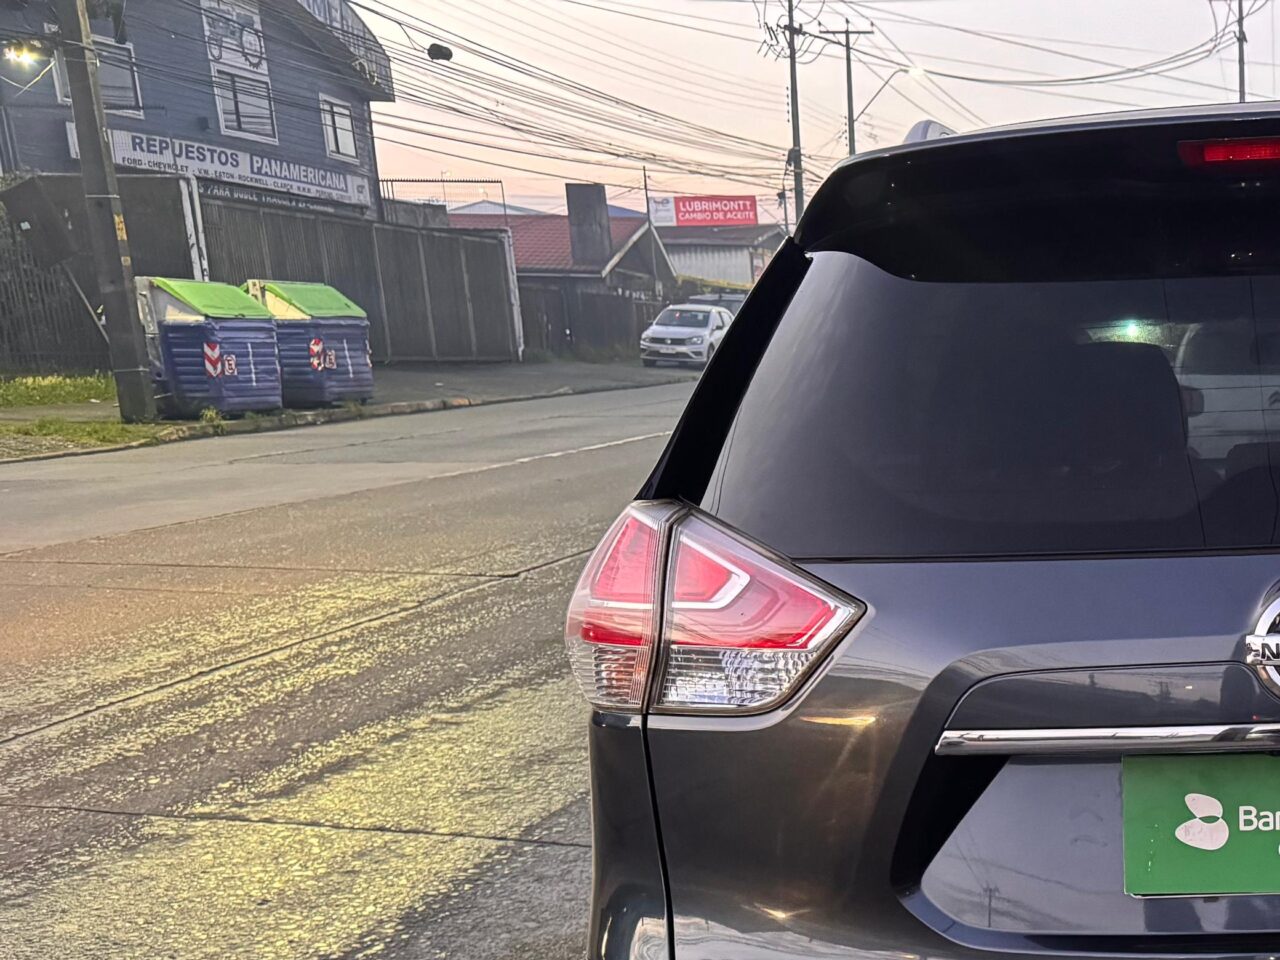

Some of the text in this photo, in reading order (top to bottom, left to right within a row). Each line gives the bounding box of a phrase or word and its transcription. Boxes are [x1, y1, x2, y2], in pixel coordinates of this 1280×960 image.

[122, 156, 143, 166] FORD
[148, 160, 189, 173] CHEVROLET
[131, 135, 346, 191] REPUESTOS PANAMERICANA
[680, 200, 752, 211] LUBRIMONTT
[678, 212, 711, 220] CAMBIO
[713, 211, 724, 220] DE
[726, 211, 754, 220] ACEITE
